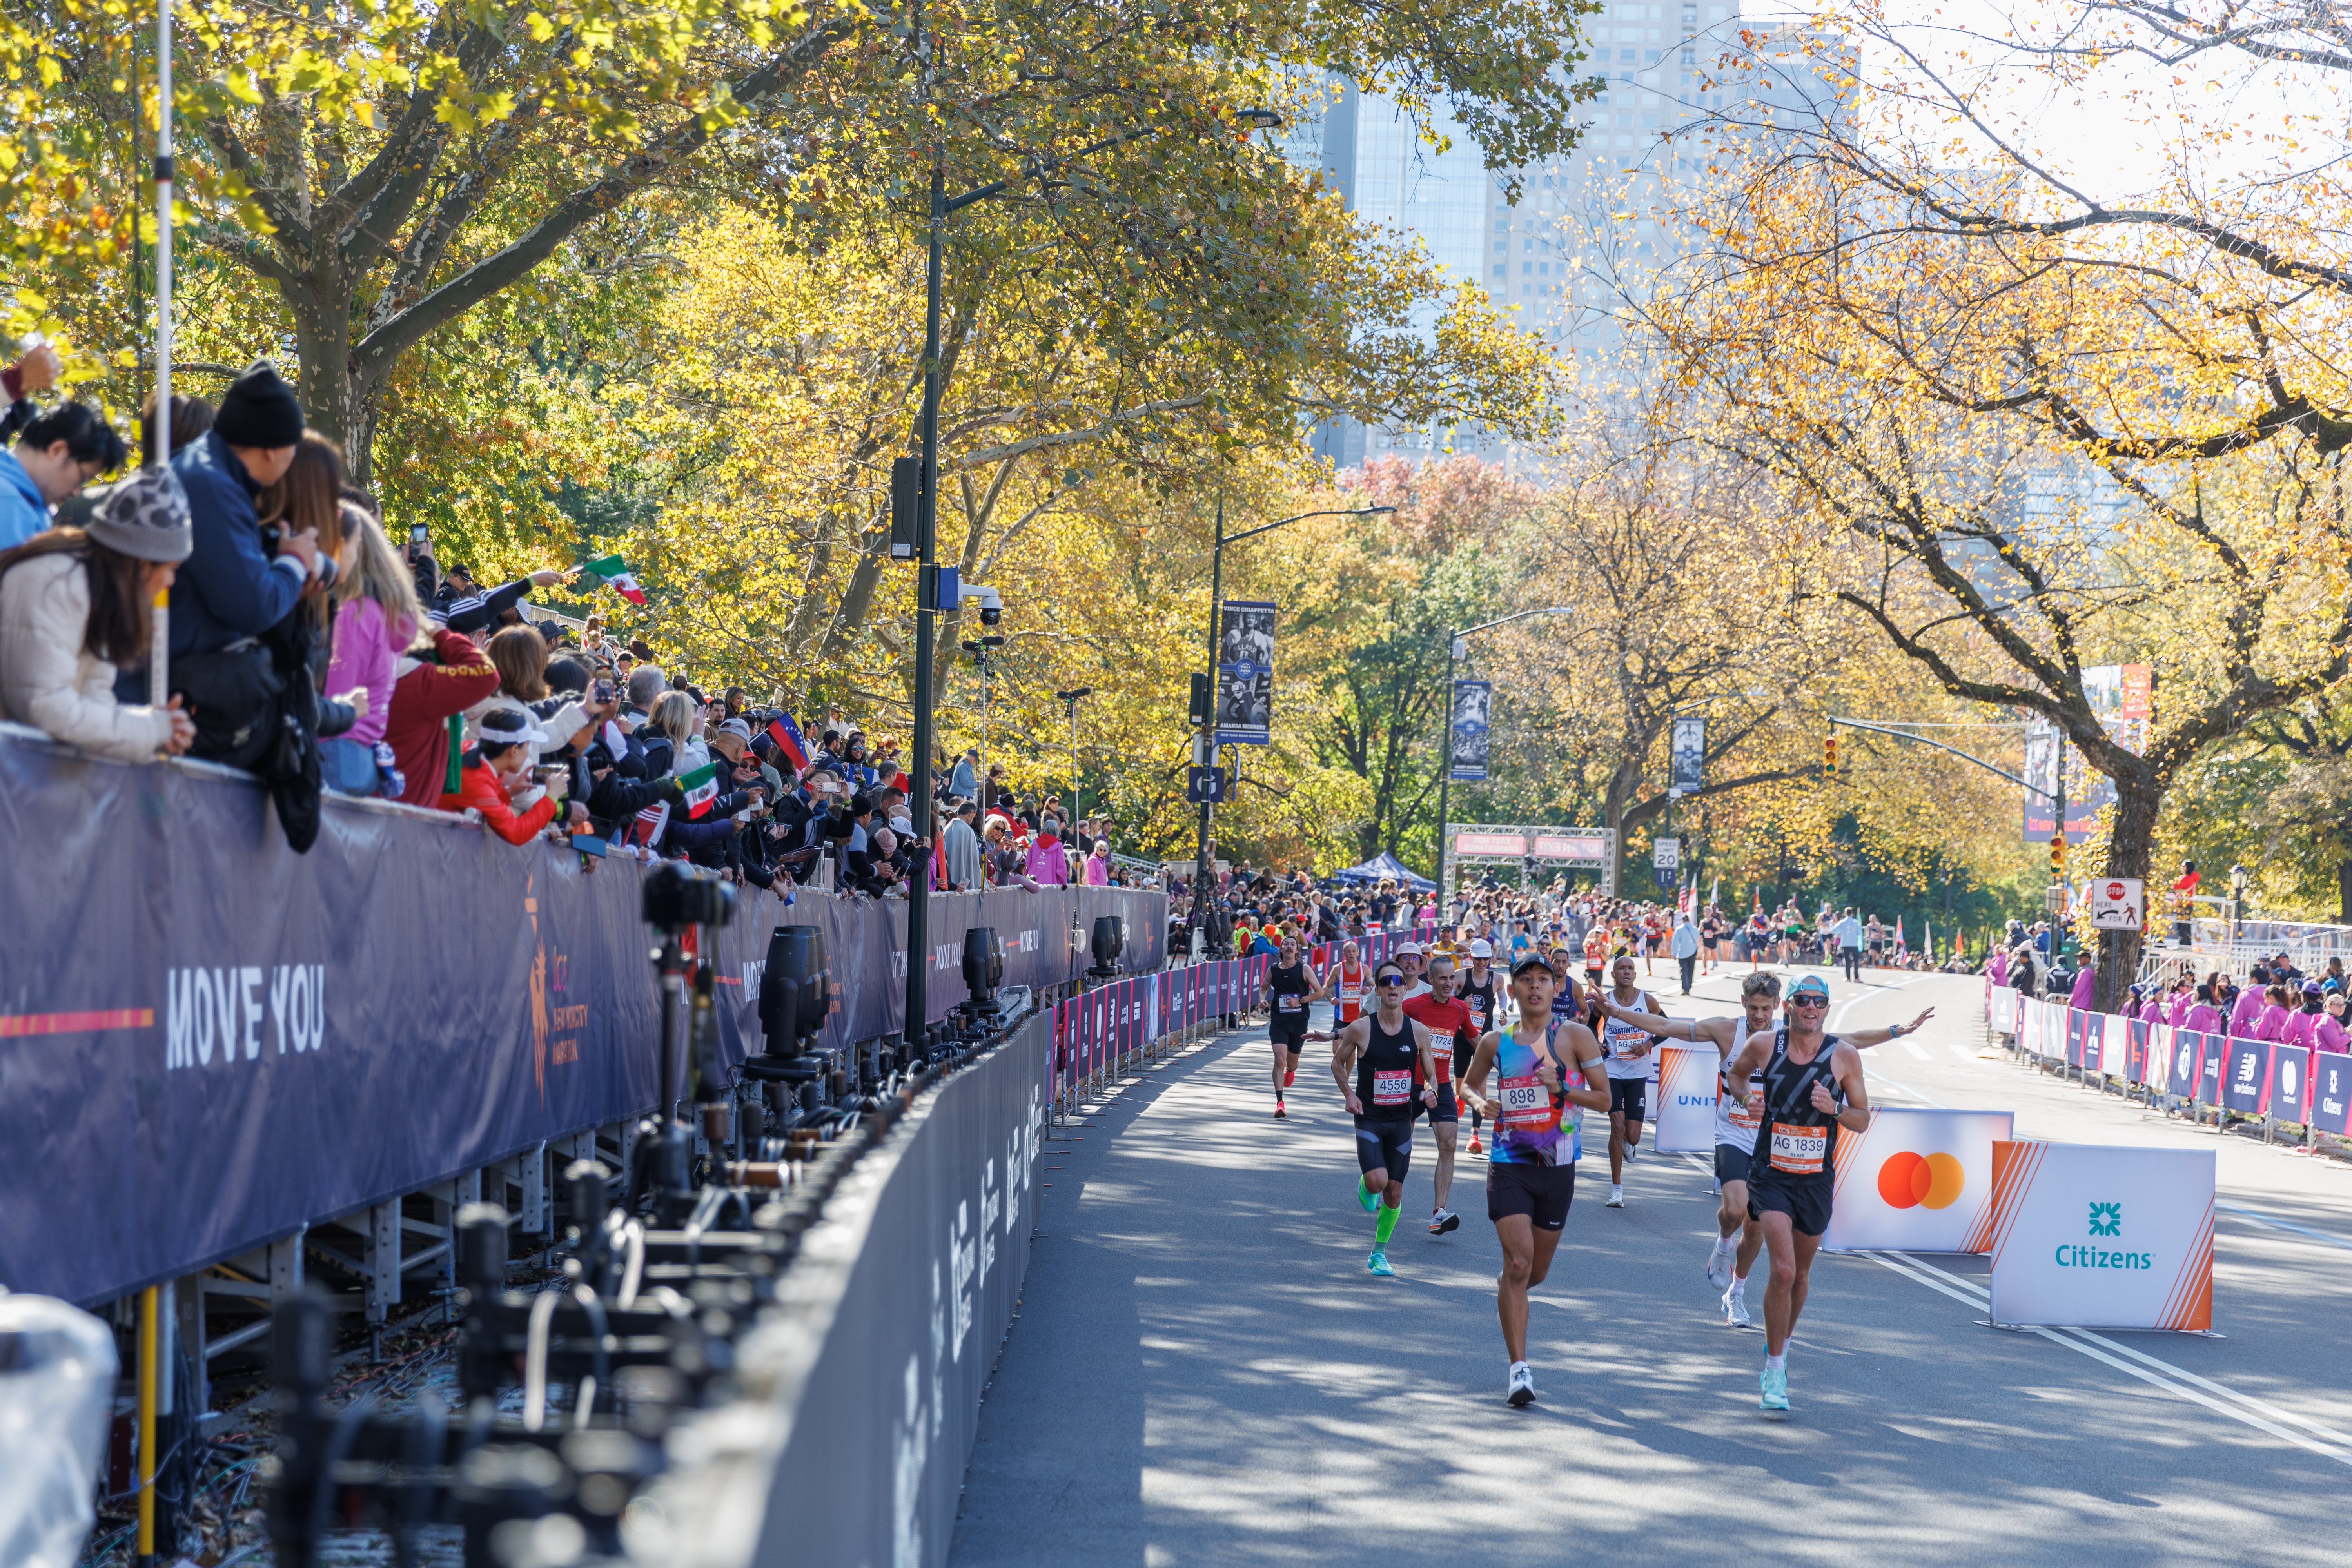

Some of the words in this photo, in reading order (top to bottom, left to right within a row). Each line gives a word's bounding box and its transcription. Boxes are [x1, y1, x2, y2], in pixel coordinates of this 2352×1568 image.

[1658, 855, 1675, 865] 20
[2107, 887, 2125, 895] STOP
[166, 966, 263, 1071] MOVE
[270, 964, 325, 1055] YOU
[1471, 1016, 1484, 1024] 1763
[1436, 1036, 1452, 1045] 1724
[1380, 1079, 1406, 1091] 4556
[1510, 1088, 1536, 1105] 898
[1679, 1096, 1717, 1107] UNIT
[1779, 1126, 1790, 1134] tcs
[1773, 1136, 1790, 1149] AG
[1795, 1139, 1823, 1151] 1839
[2055, 1244, 2151, 1270] Citizens
